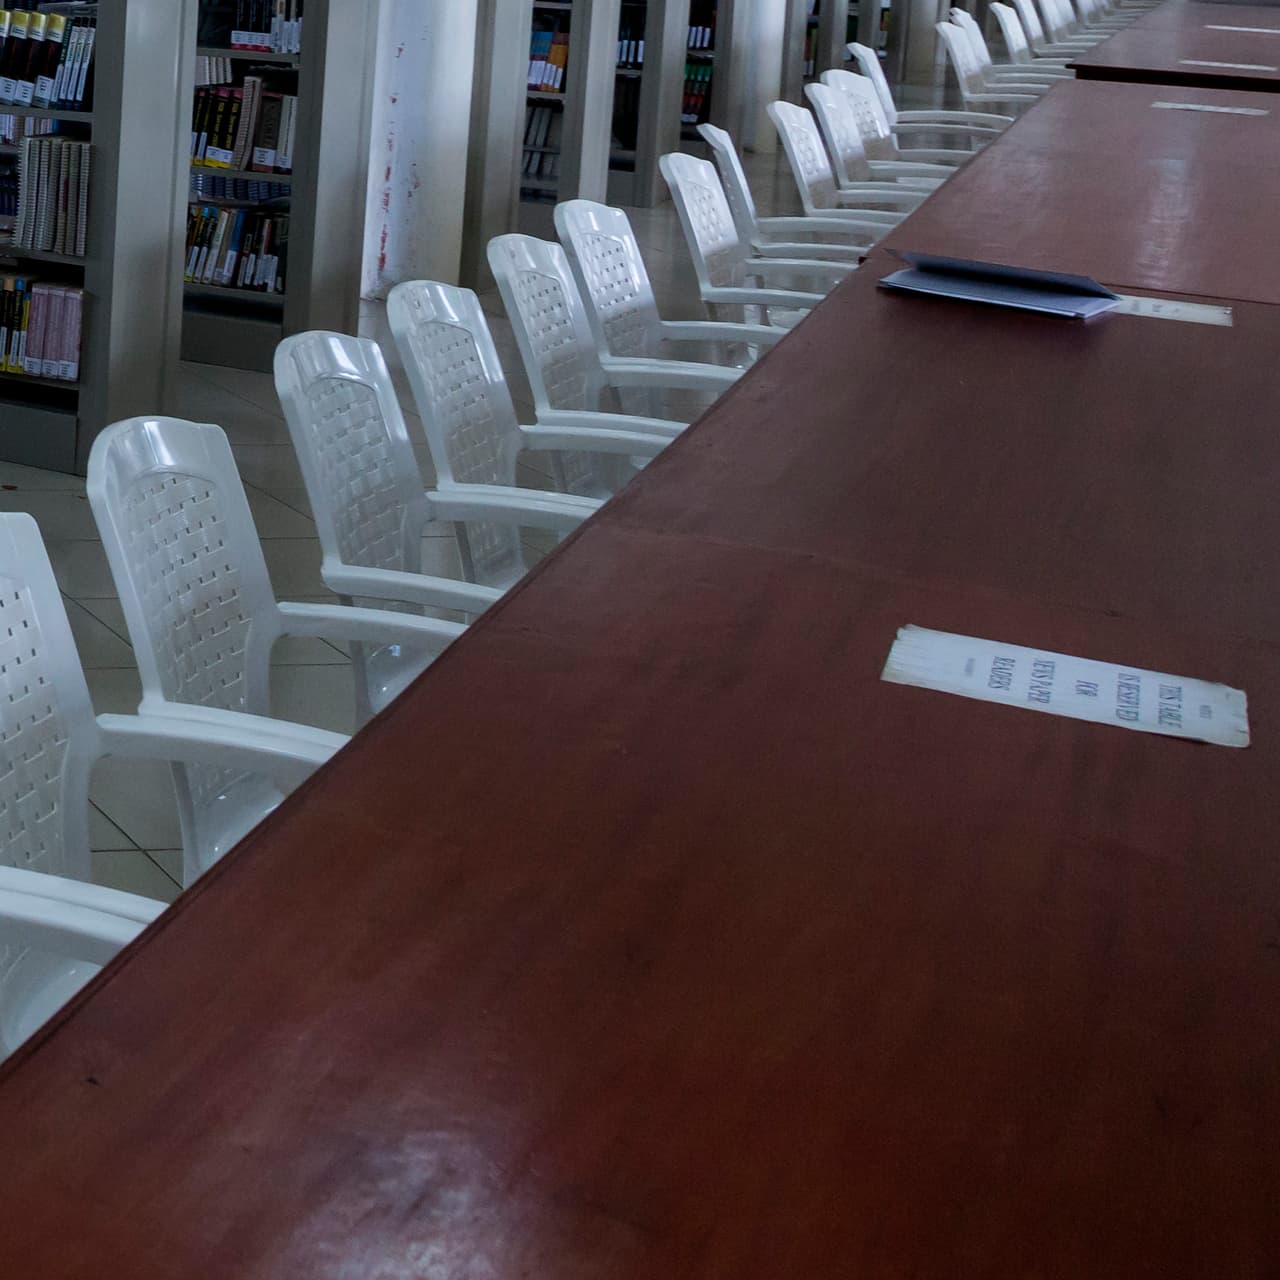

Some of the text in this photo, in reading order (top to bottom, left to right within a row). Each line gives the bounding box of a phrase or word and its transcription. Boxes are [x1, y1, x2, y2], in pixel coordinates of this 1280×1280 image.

[987, 655, 1016, 691] READERS
[1074, 679, 1100, 697] FOR
[1115, 673, 1140, 722] IS RESERVED
[1158, 684, 1183, 729] THIS TABLE
